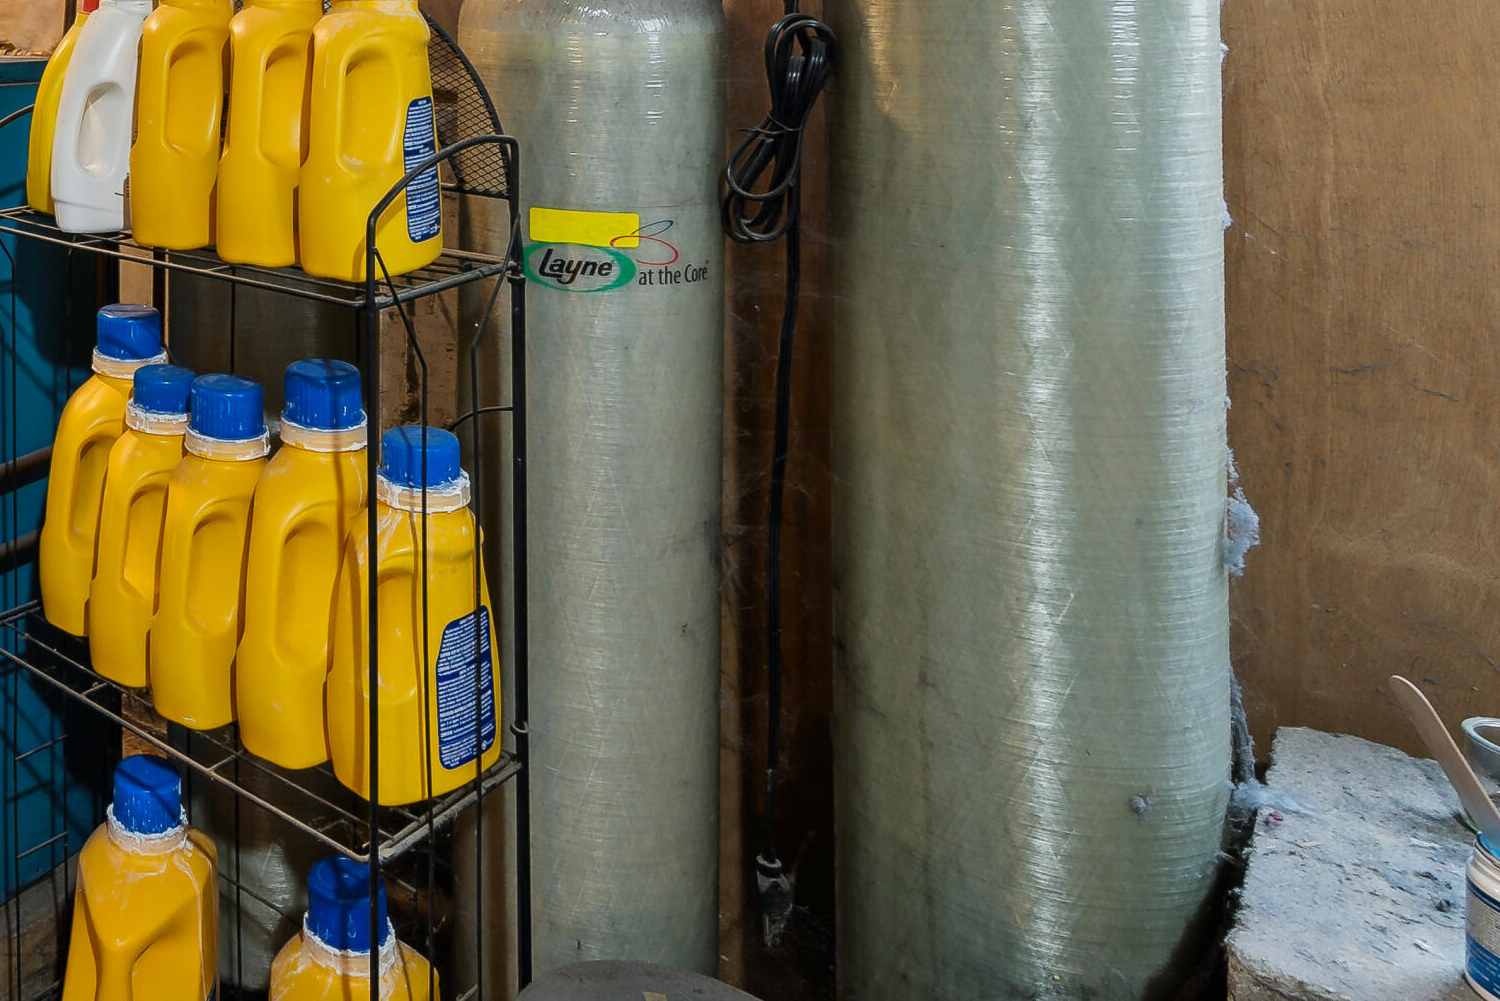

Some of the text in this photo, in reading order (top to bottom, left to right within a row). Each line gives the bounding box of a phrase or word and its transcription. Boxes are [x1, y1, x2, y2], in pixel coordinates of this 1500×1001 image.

[539, 248, 708, 285] Layne at the Core
